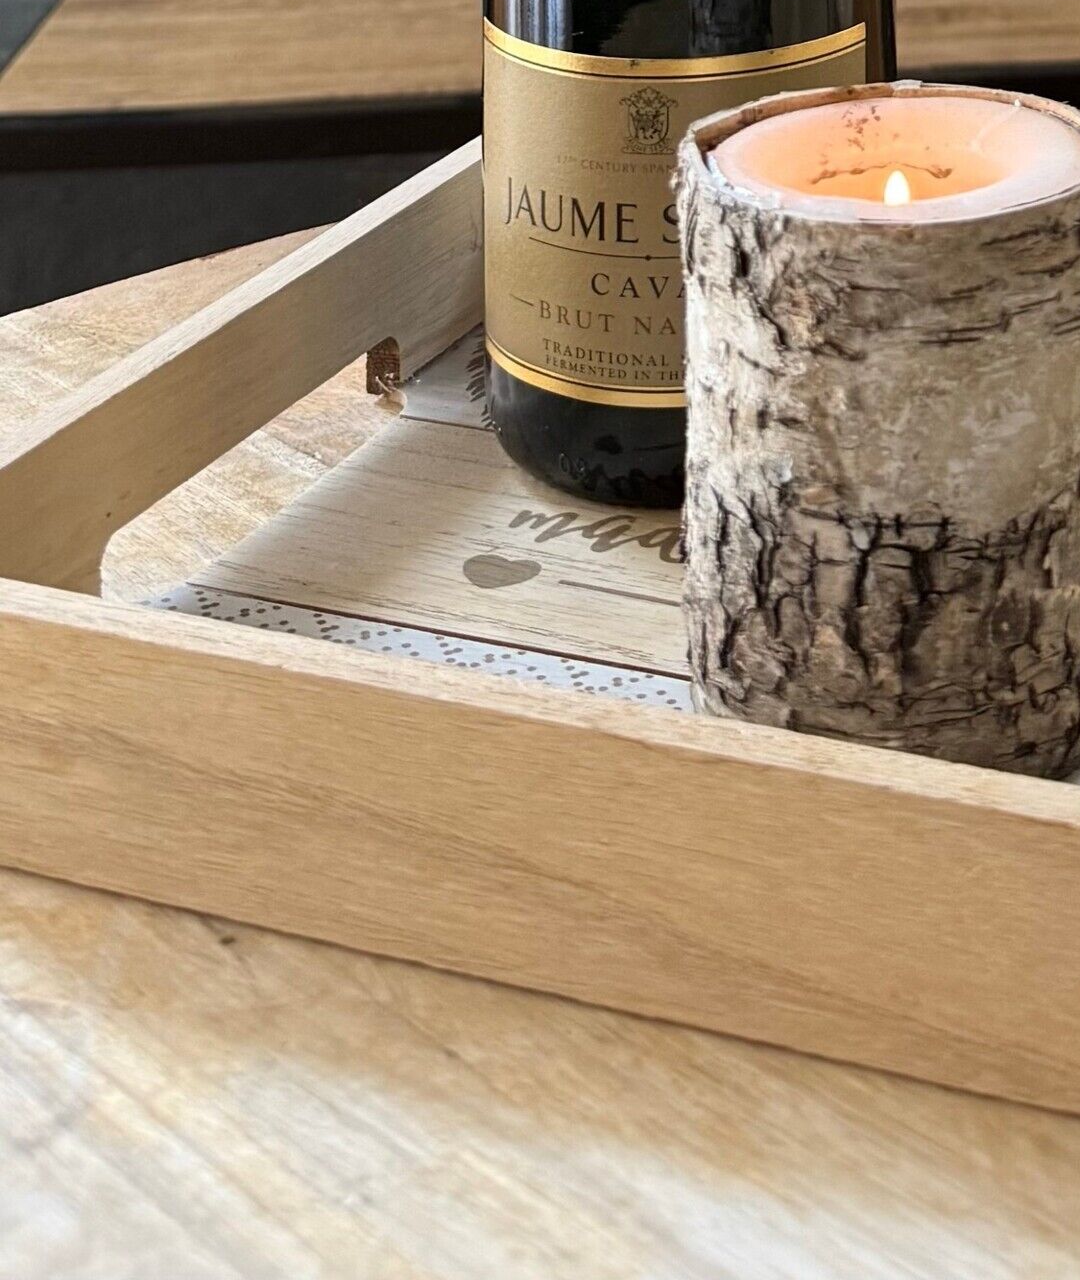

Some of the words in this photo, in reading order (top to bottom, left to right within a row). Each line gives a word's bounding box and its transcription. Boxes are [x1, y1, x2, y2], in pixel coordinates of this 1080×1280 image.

[581, 159, 637, 174] CENTURY
[505, 177, 639, 244] JAUME
[540, 300, 615, 333] BRUT
[542, 338, 670, 368] TRADITIONAL
[546, 354, 628, 380] FERMENTED
[634, 369, 652, 381] IN
